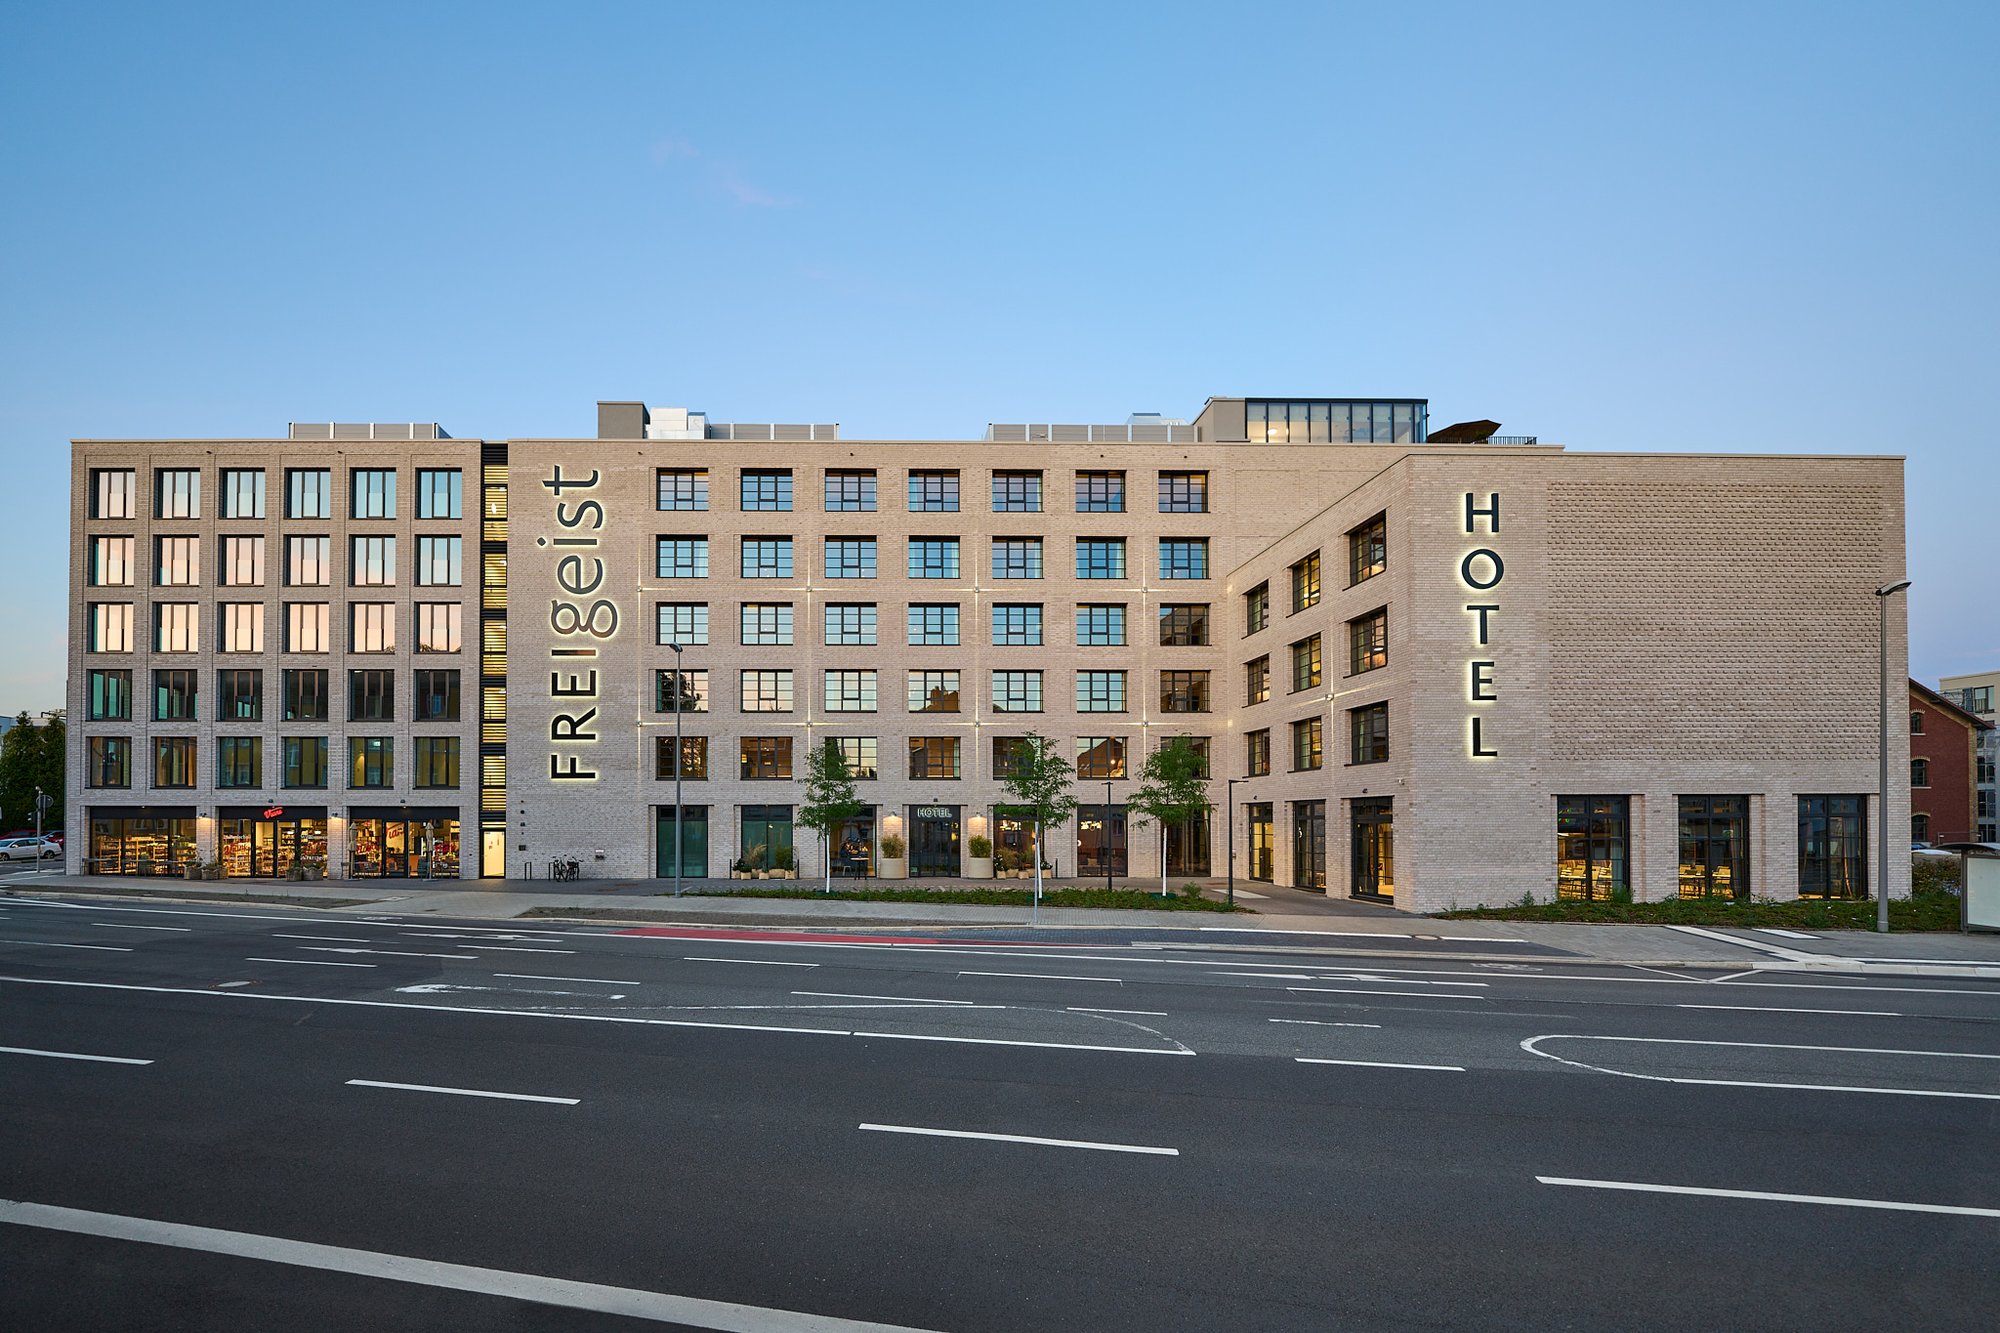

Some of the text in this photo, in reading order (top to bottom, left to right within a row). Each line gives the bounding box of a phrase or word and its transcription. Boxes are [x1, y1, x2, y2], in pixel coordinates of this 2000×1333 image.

[537, 465, 618, 779] FREIgeist
[1461, 492, 1505, 757] HOTEL
[917, 807, 953, 818] HOTEL
